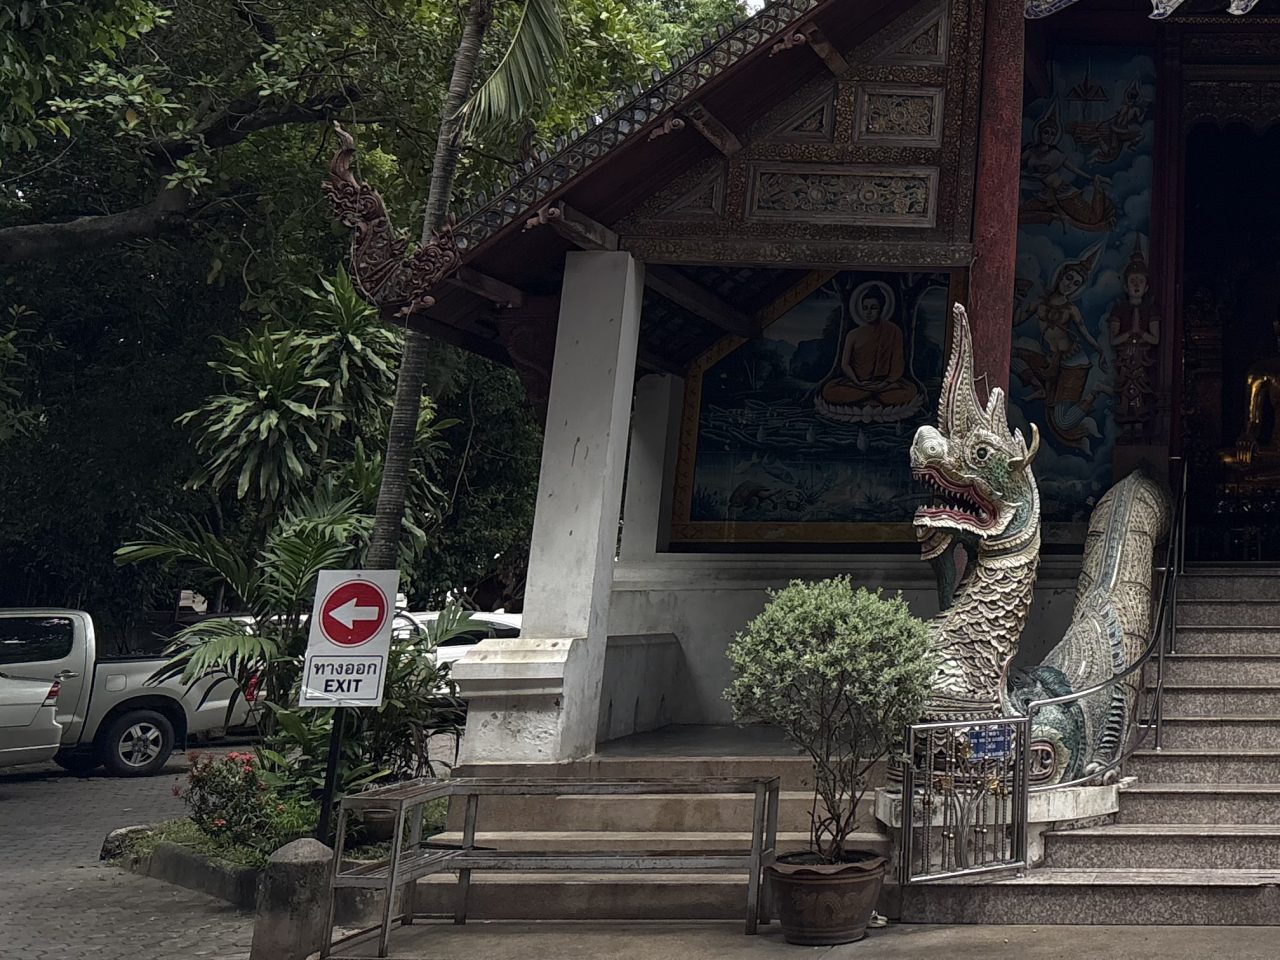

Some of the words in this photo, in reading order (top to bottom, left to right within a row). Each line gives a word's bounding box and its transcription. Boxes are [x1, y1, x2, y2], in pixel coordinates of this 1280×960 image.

[314, 663, 377, 675] ทางออก
[324, 679, 363, 693] EXIT
